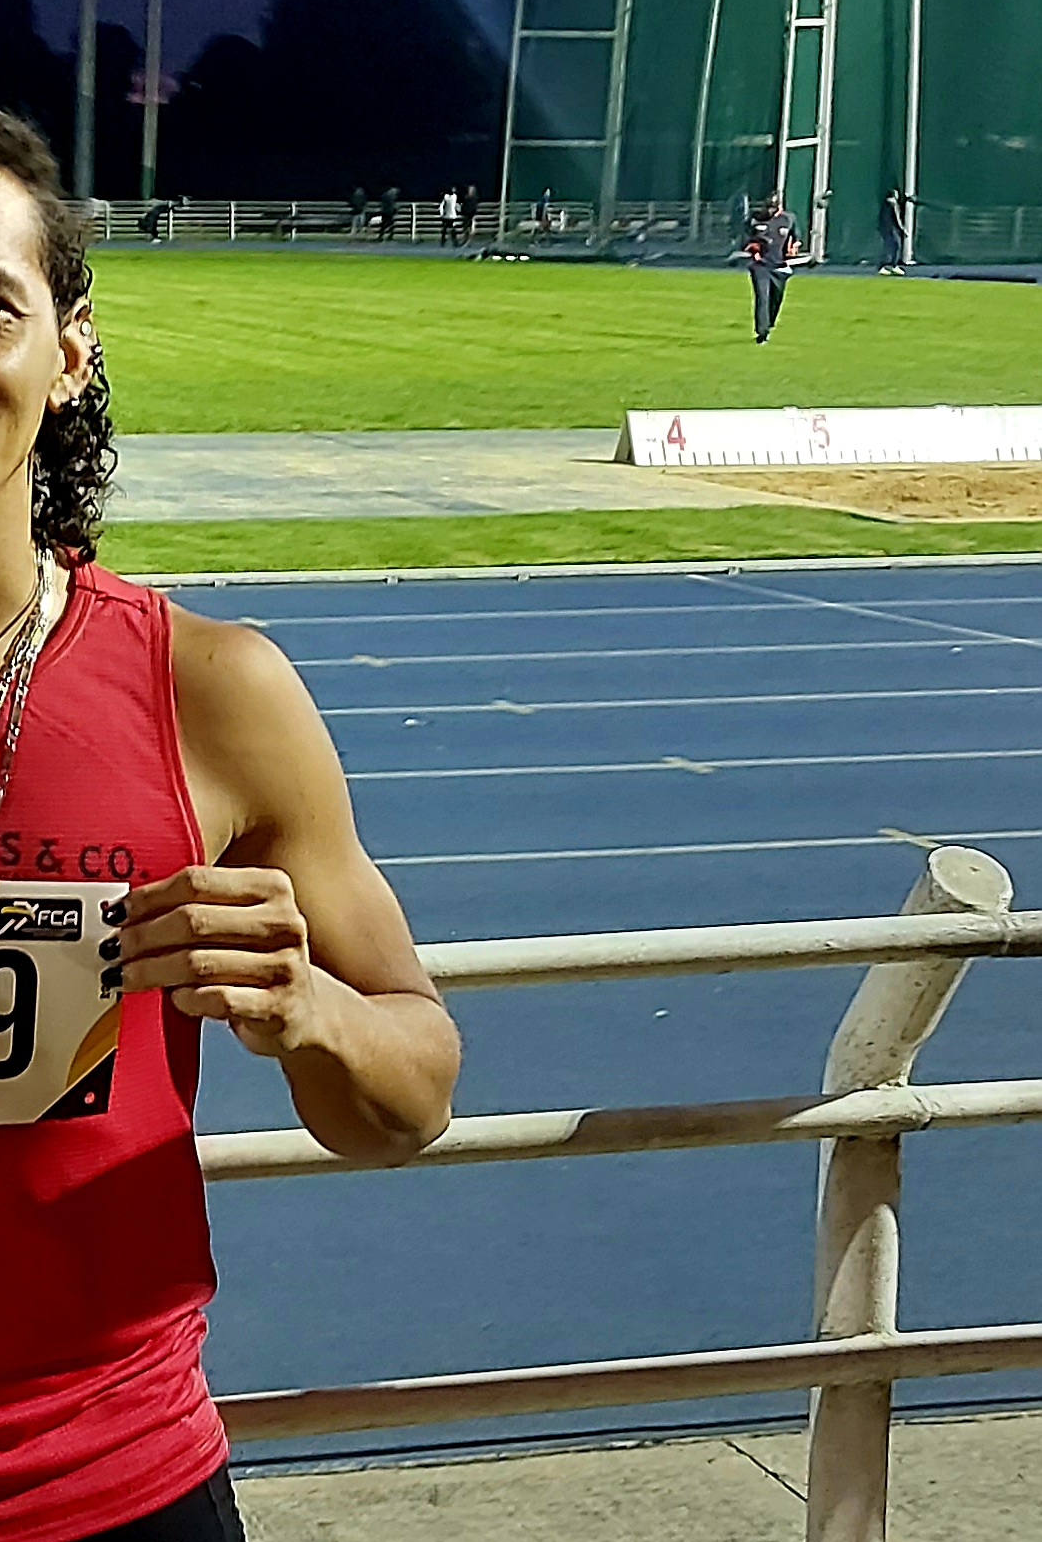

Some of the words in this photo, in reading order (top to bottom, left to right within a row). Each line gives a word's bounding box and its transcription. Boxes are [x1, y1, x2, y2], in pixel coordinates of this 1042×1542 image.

[666, 415, 687, 451] 4
[811, 414, 831, 450] 5
[34, 839, 64, 874] &
[78, 846, 148, 880] CO.
[38, 910, 79, 927] FCA
